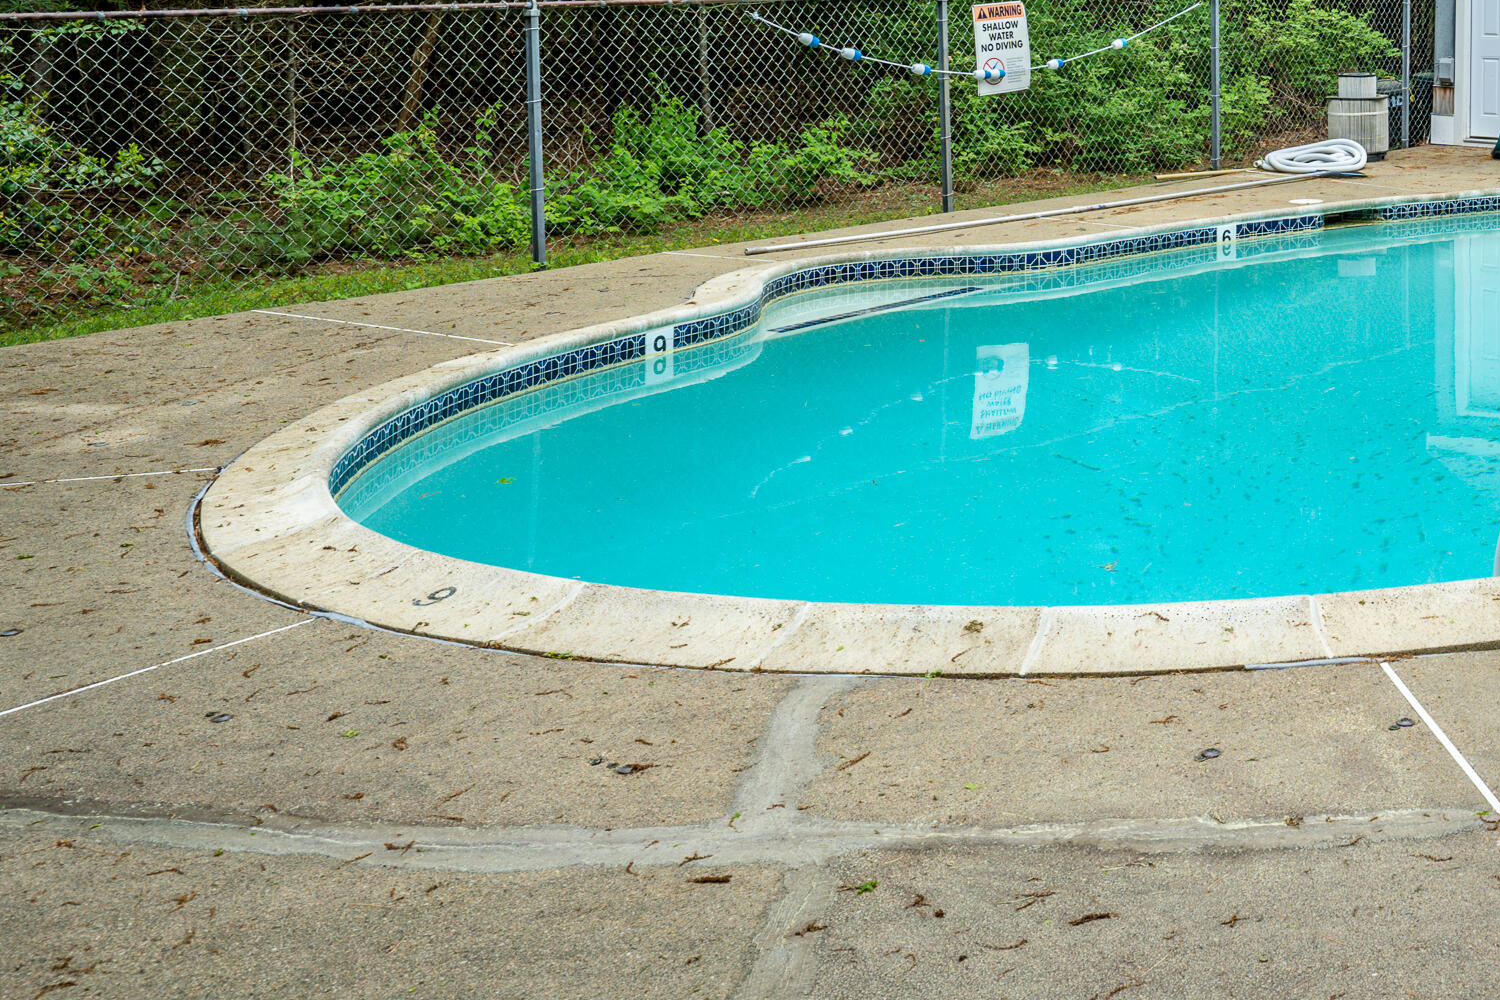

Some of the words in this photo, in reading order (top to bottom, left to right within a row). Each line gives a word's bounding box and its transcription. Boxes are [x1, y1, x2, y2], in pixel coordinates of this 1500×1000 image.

[988, 5, 1021, 18] WARNING
[982, 20, 1019, 32] SHALLOW
[988, 31, 1014, 41] WATER
[981, 44, 994, 52] NO
[996, 40, 1024, 51] DIVING
[1222, 229, 1231, 242] 6
